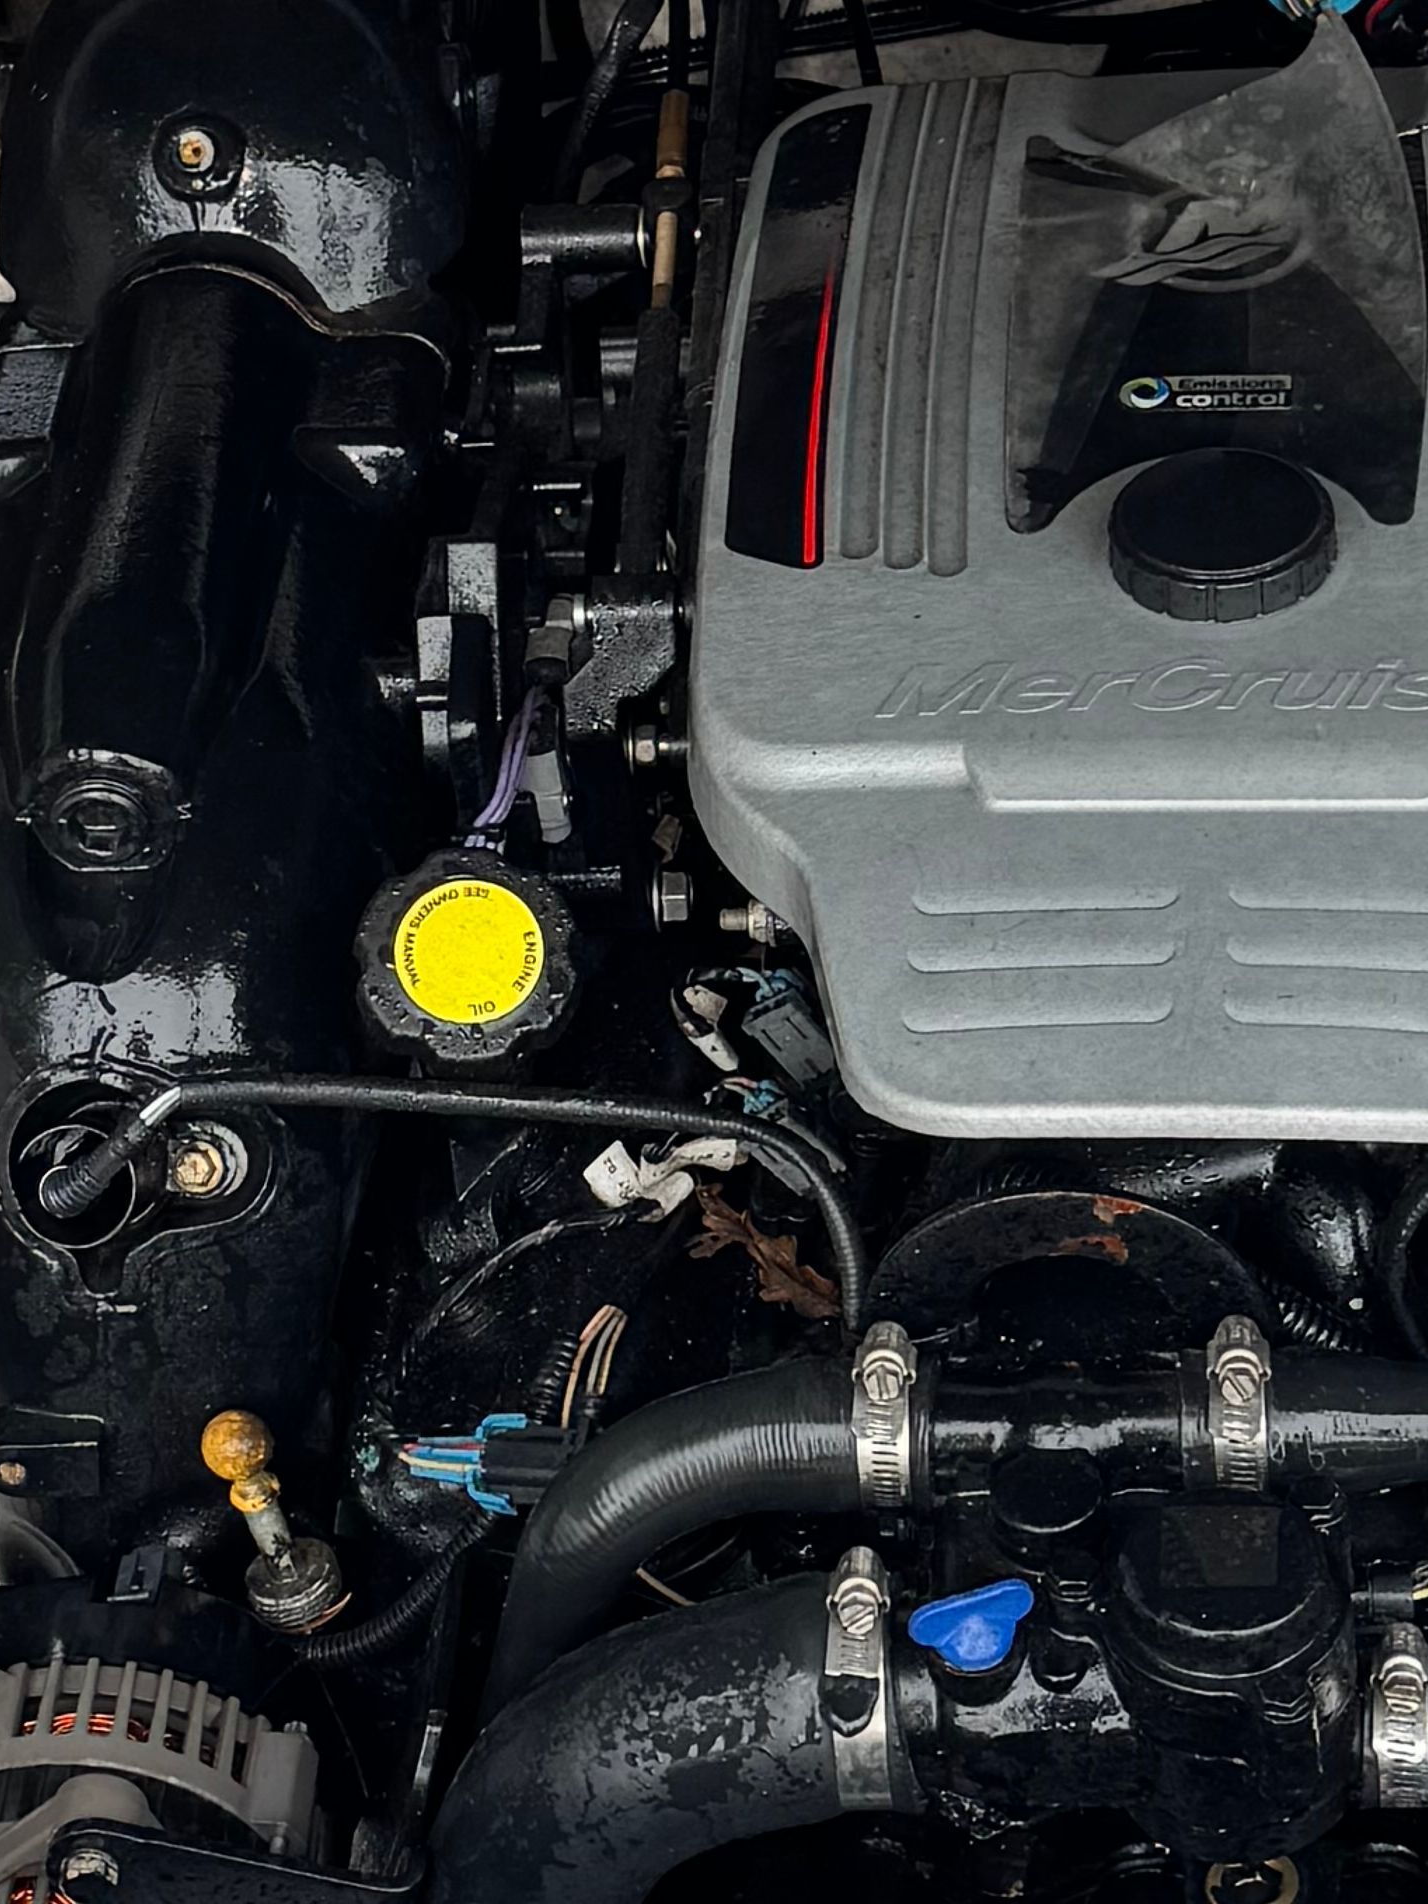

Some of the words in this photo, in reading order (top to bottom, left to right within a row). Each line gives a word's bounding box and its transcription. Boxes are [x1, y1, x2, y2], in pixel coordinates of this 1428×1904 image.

[1178, 378, 1287, 391] Emissions
[1175, 391, 1287, 408] control
[511, 930, 538, 993] ENGINE
[467, 1000, 496, 1016] OIL
